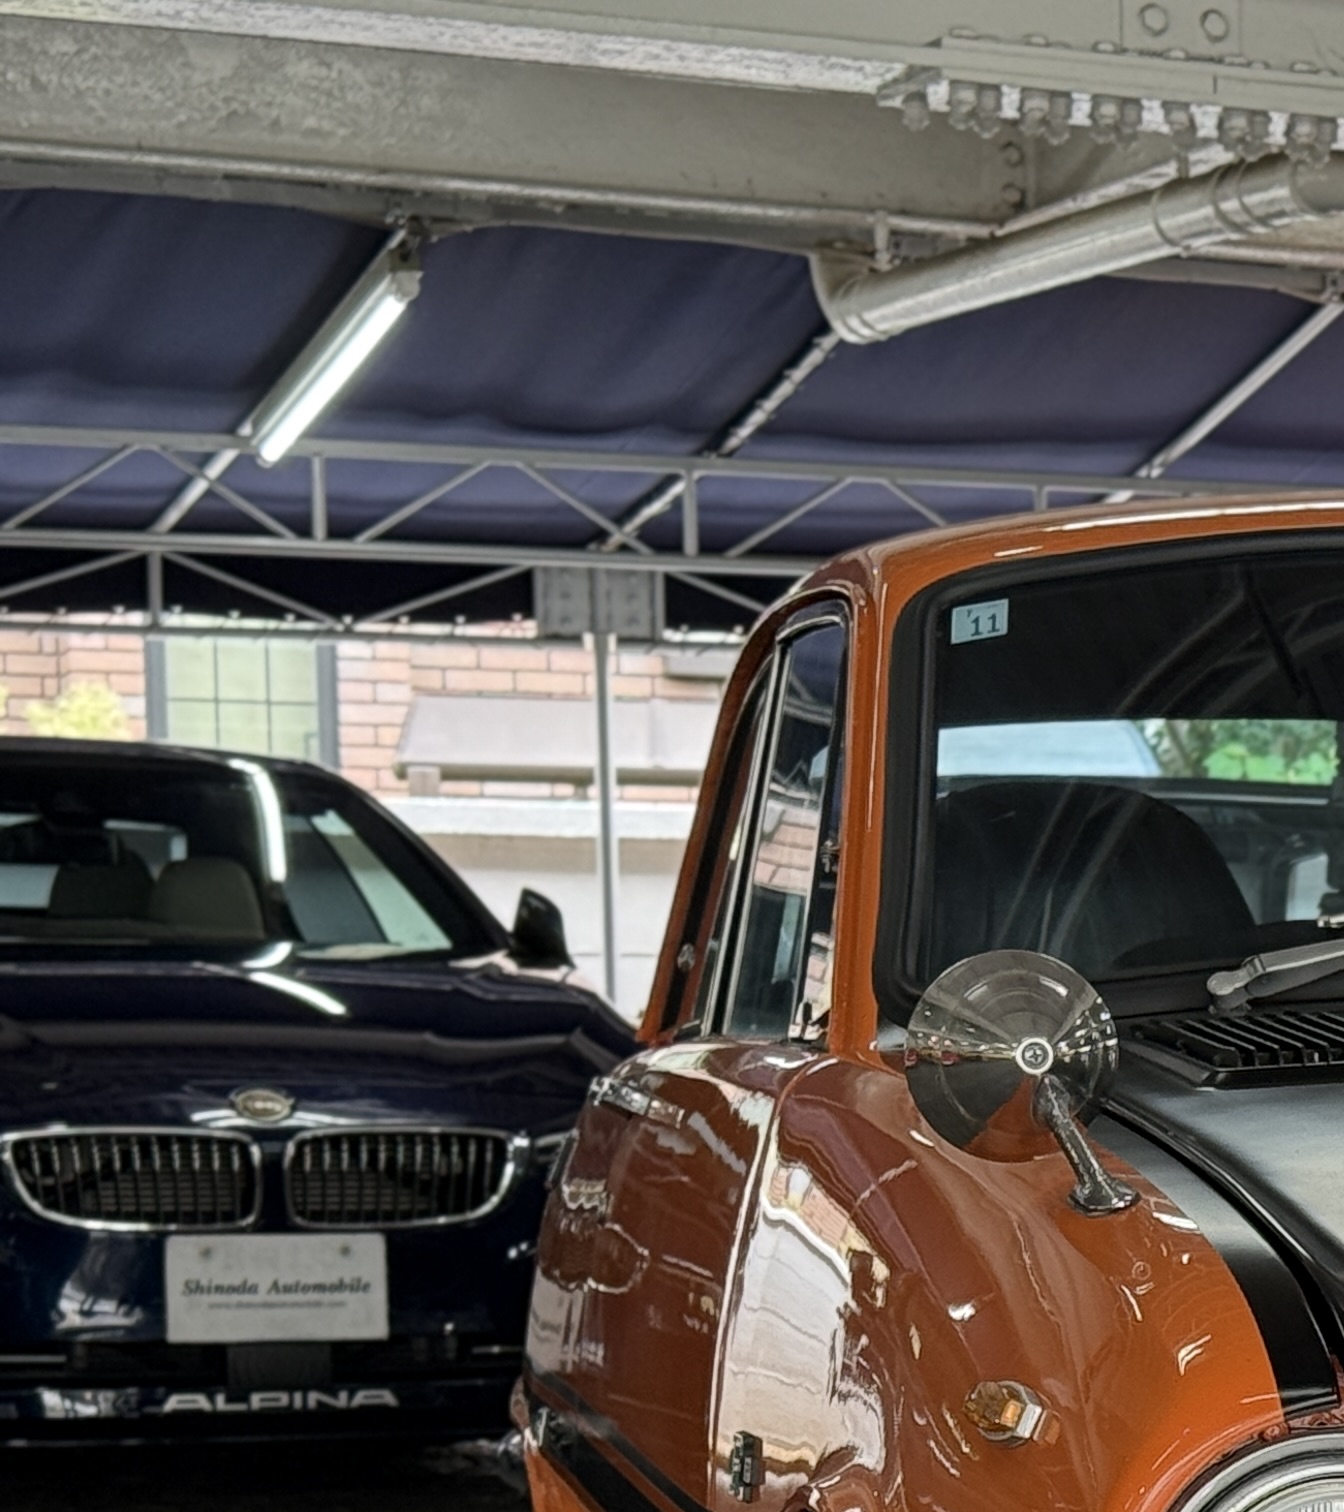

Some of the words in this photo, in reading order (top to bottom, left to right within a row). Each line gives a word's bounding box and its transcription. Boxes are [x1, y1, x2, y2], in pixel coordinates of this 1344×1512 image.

[182, 1278, 258, 1296] Shinoda
[267, 1276, 371, 1295] Automobile
[163, 1389, 399, 1412] ALPINA
